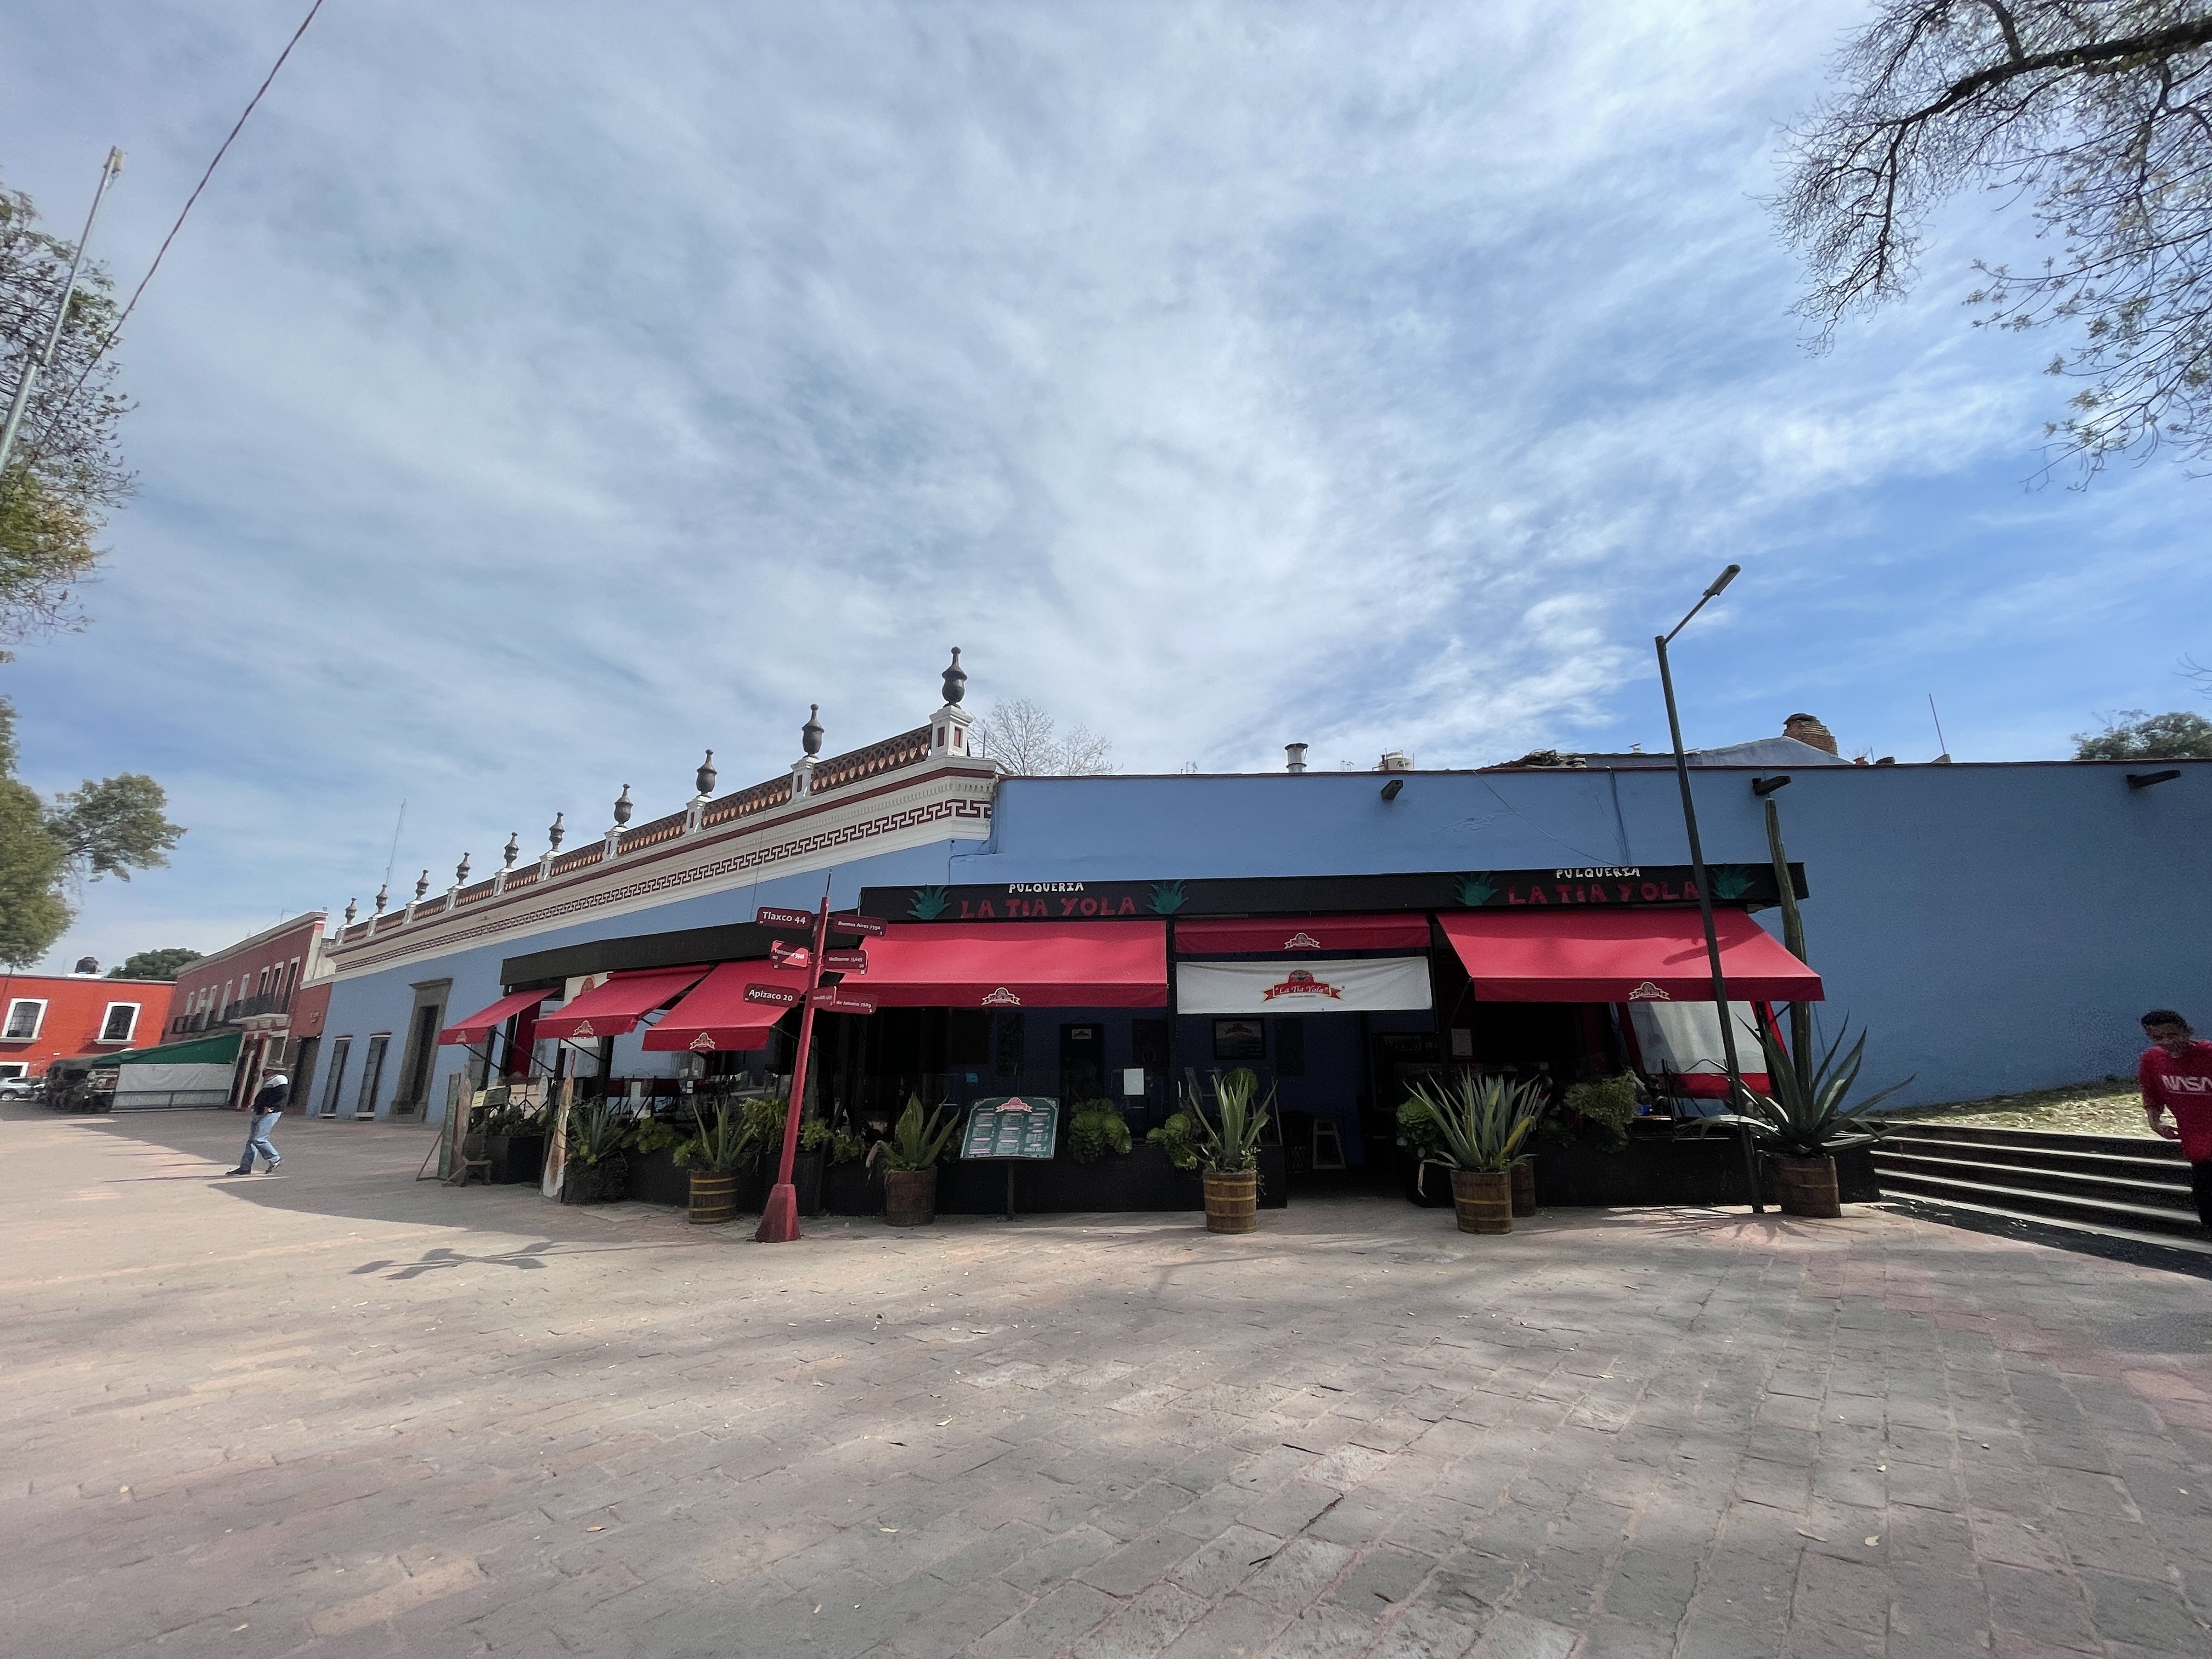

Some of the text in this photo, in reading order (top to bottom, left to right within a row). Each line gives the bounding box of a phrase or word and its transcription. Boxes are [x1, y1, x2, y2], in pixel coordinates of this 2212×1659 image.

[1556, 867, 1640, 878] PULQUERIA
[1008, 882, 1085, 894] PULQUERIA
[1507, 881, 1700, 905] LA TIA YOLA
[960, 896, 1137, 919] LA TIA YOLA
[763, 911, 806, 925] Tlaxco 44
[748, 989, 781, 1000] Apizaco
[2162, 1074, 2212, 1092] NASA
